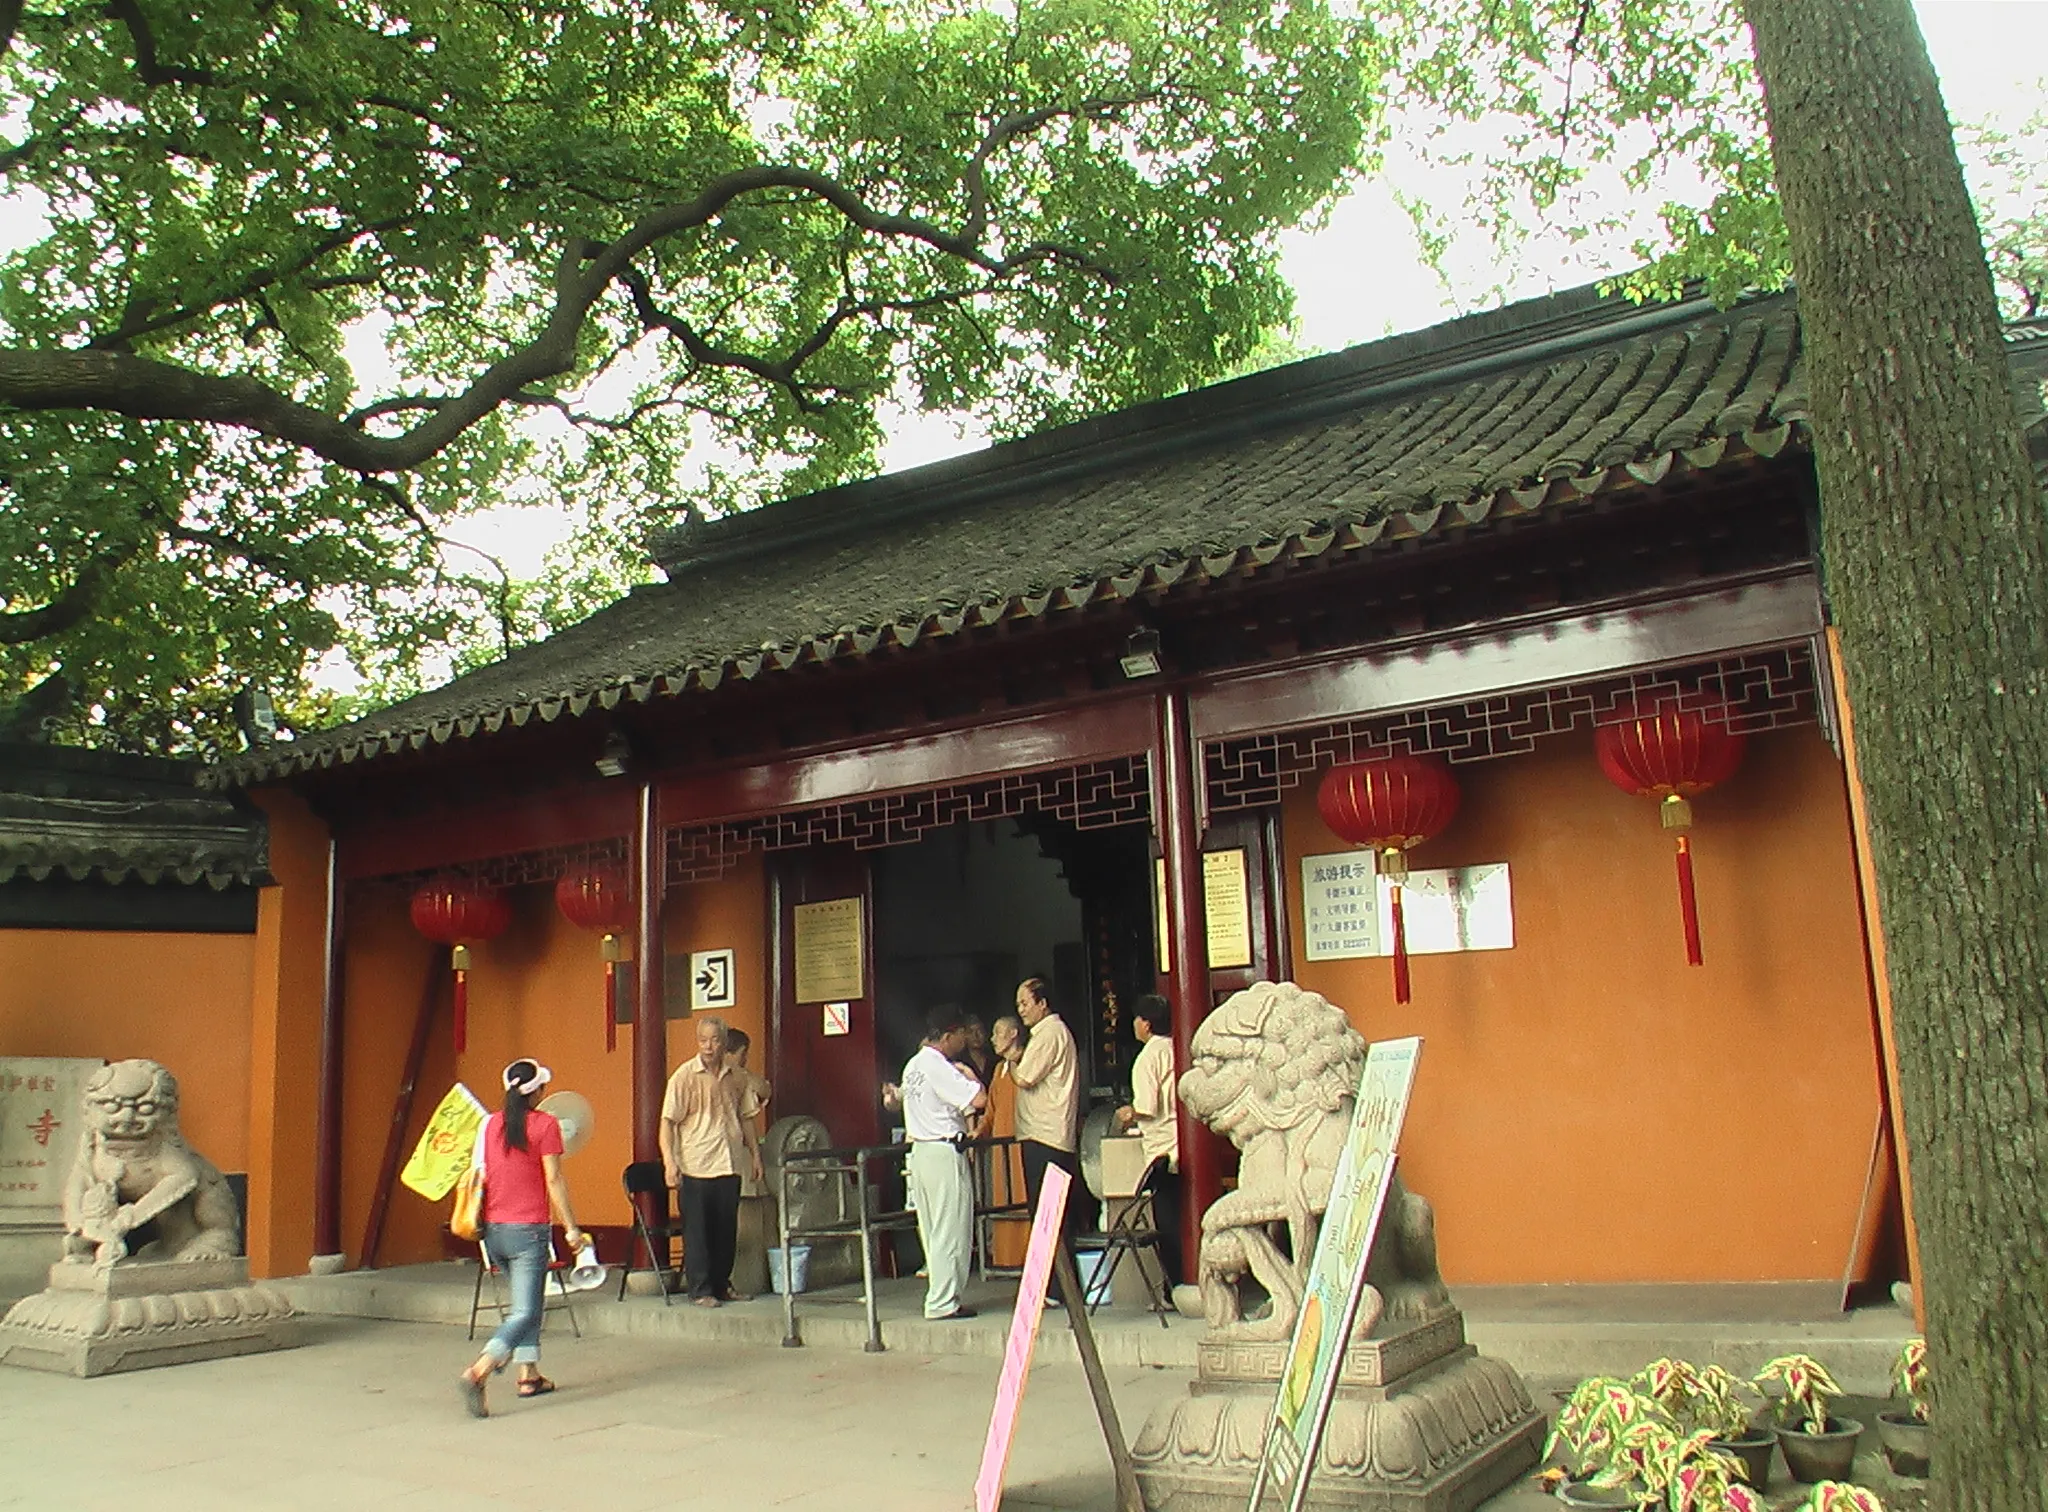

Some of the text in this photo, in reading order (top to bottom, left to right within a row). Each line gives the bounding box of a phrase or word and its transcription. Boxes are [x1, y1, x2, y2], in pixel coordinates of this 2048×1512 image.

[1313, 863, 1365, 883] 旅游提示
[26, 1109, 61, 1147] 寺
